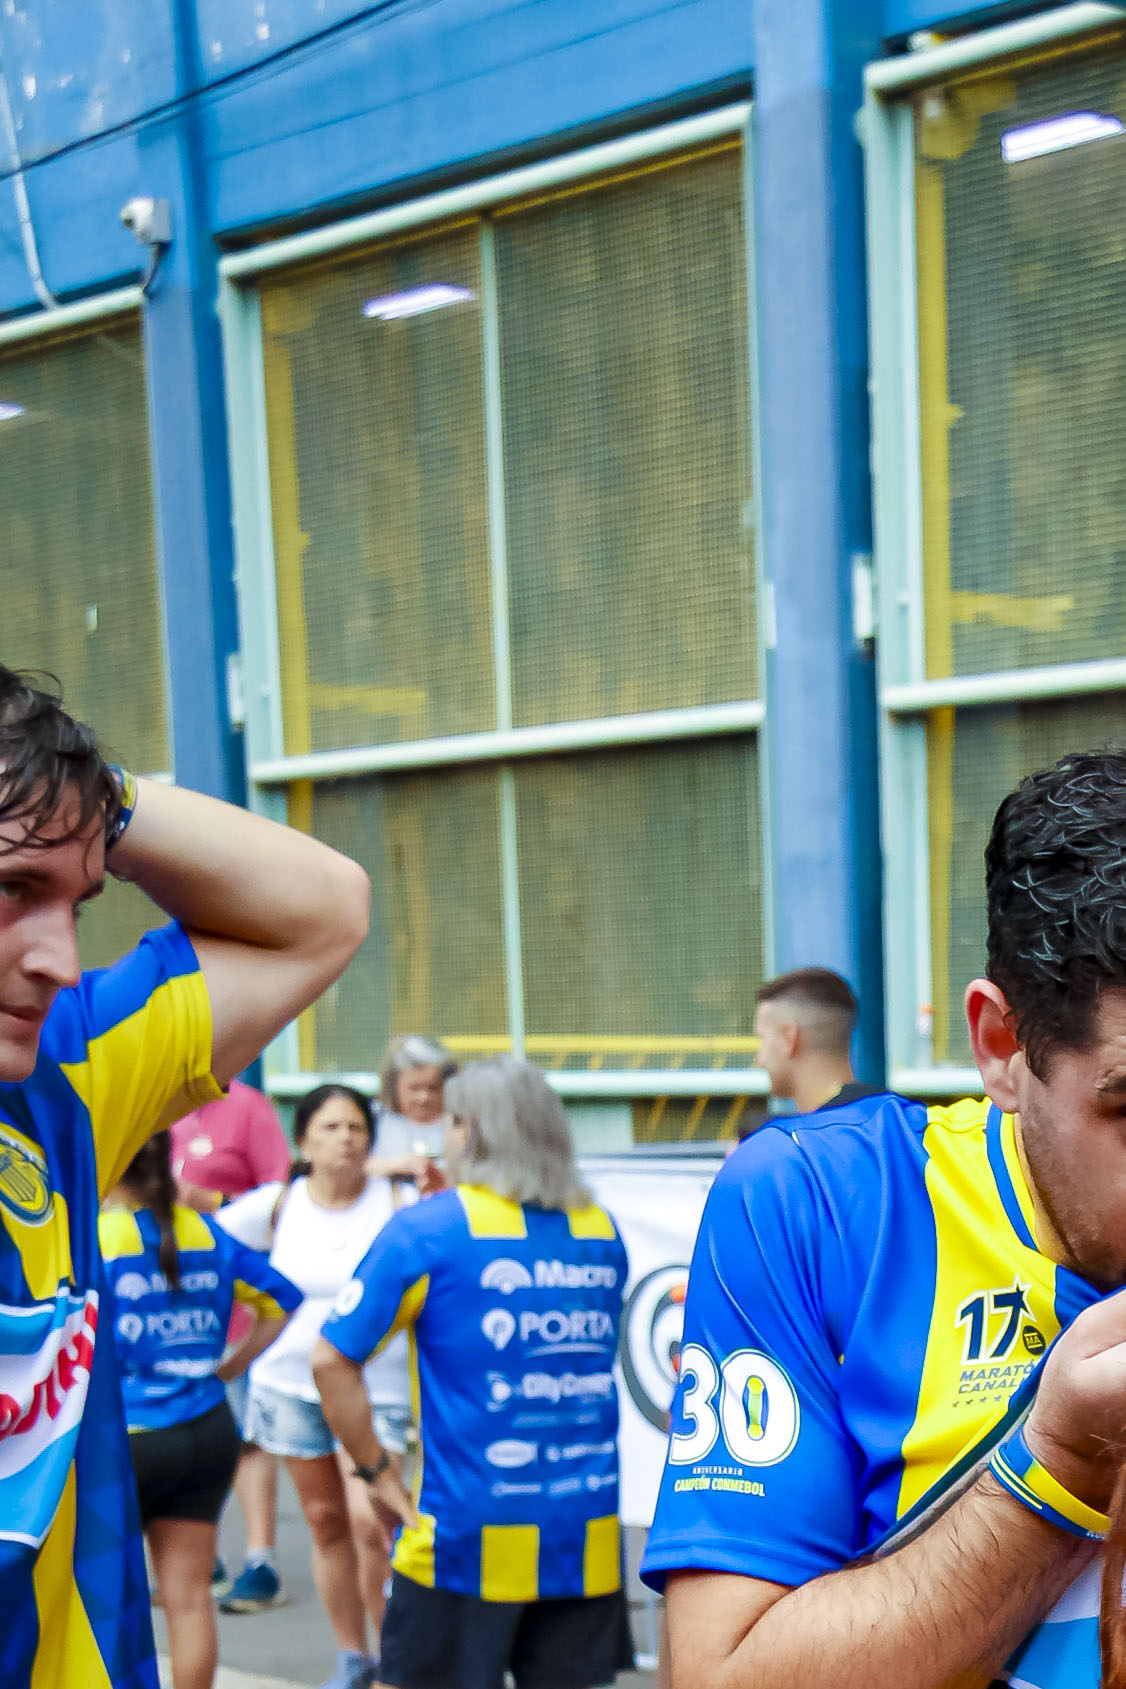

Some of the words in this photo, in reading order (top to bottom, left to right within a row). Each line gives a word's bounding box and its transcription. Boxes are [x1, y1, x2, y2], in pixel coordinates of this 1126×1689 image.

[533, 1260, 617, 1290] Macro
[519, 1309, 614, 1344] PORTA
[954, 1273, 1037, 1366] 17
[668, 1343, 801, 1467] 30
[674, 1476, 711, 1493] CAMPEÓN
